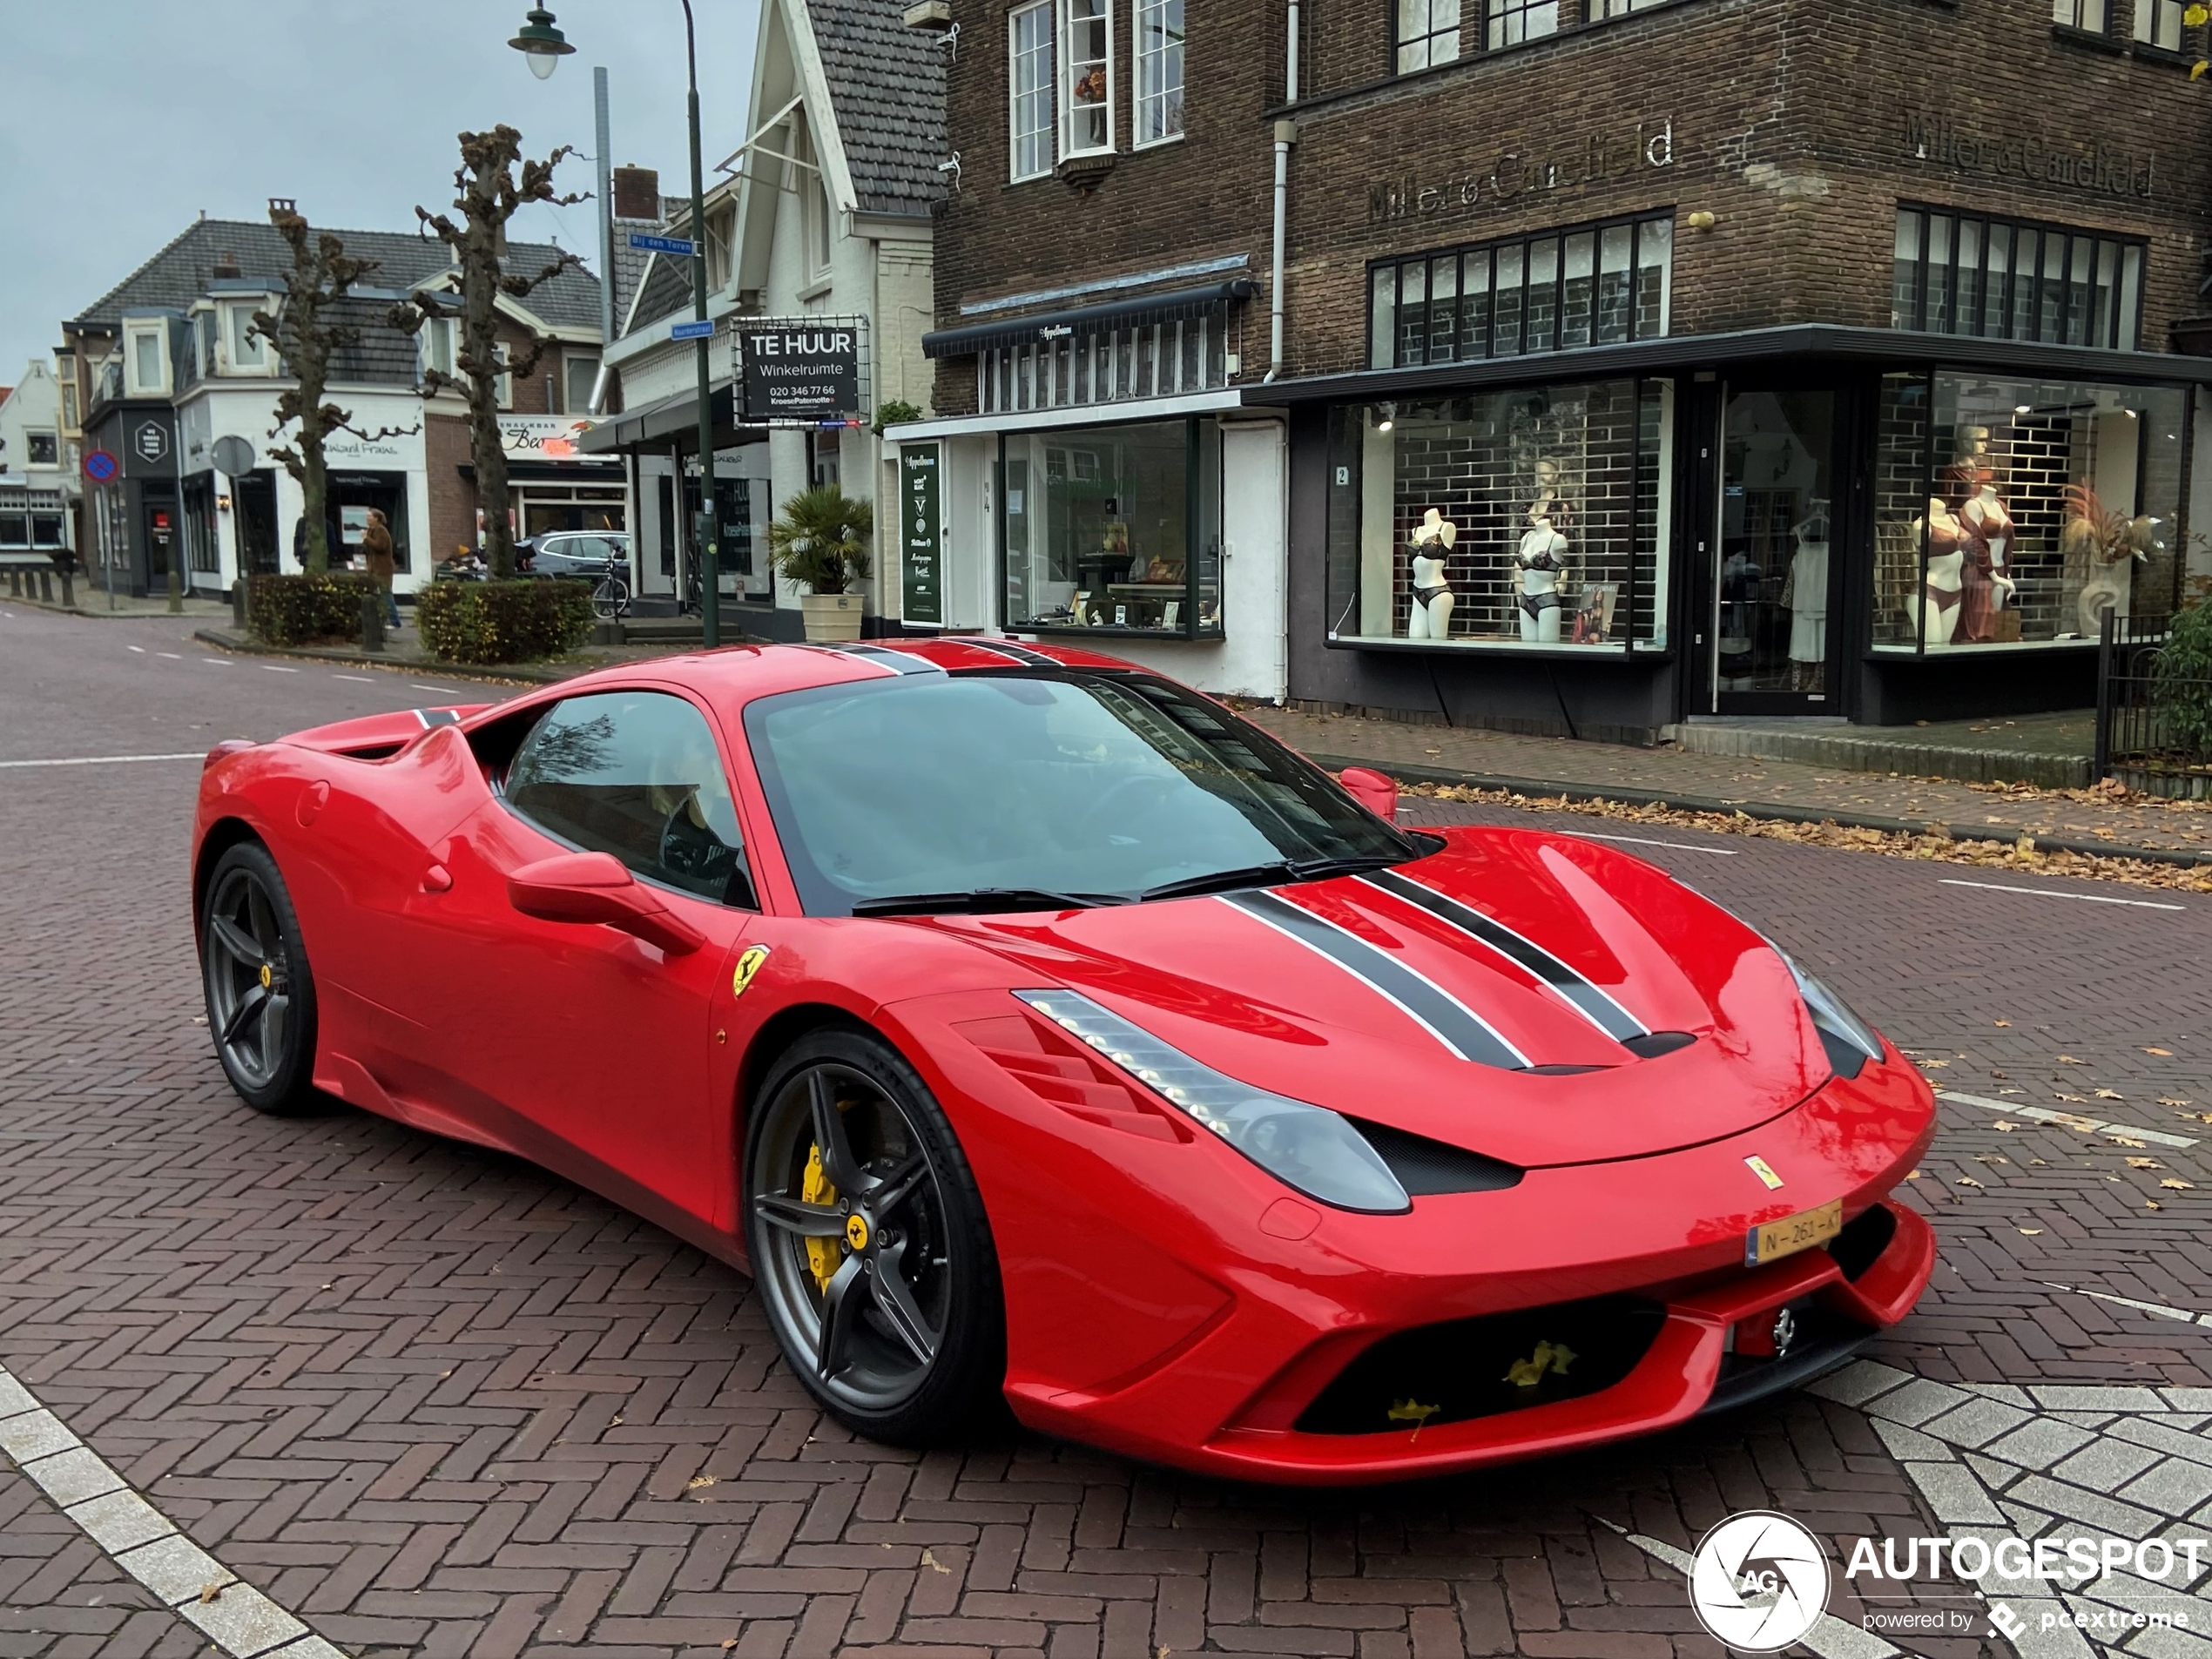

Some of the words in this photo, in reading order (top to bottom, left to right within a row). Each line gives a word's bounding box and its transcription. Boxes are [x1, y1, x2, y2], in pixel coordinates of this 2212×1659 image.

[1905, 111, 1989, 171] Miller
[2022, 133, 2156, 198] Canfield
[1369, 168, 1453, 223] Miller
[1491, 114, 1674, 199] Canfield
[632, 235, 645, 247] Bij
[648, 239, 664, 248] den
[667, 240, 691, 252] Toren
[751, 335, 779, 356] TE
[785, 334, 851, 354] HUUR
[759, 363, 844, 377] Winkelruimte
[770, 387, 789, 396] 020
[791, 386, 809, 396] 346
[810, 386, 821, 395] 77
[822, 385, 835, 395] 66
[1339, 469, 1345, 483] 2
